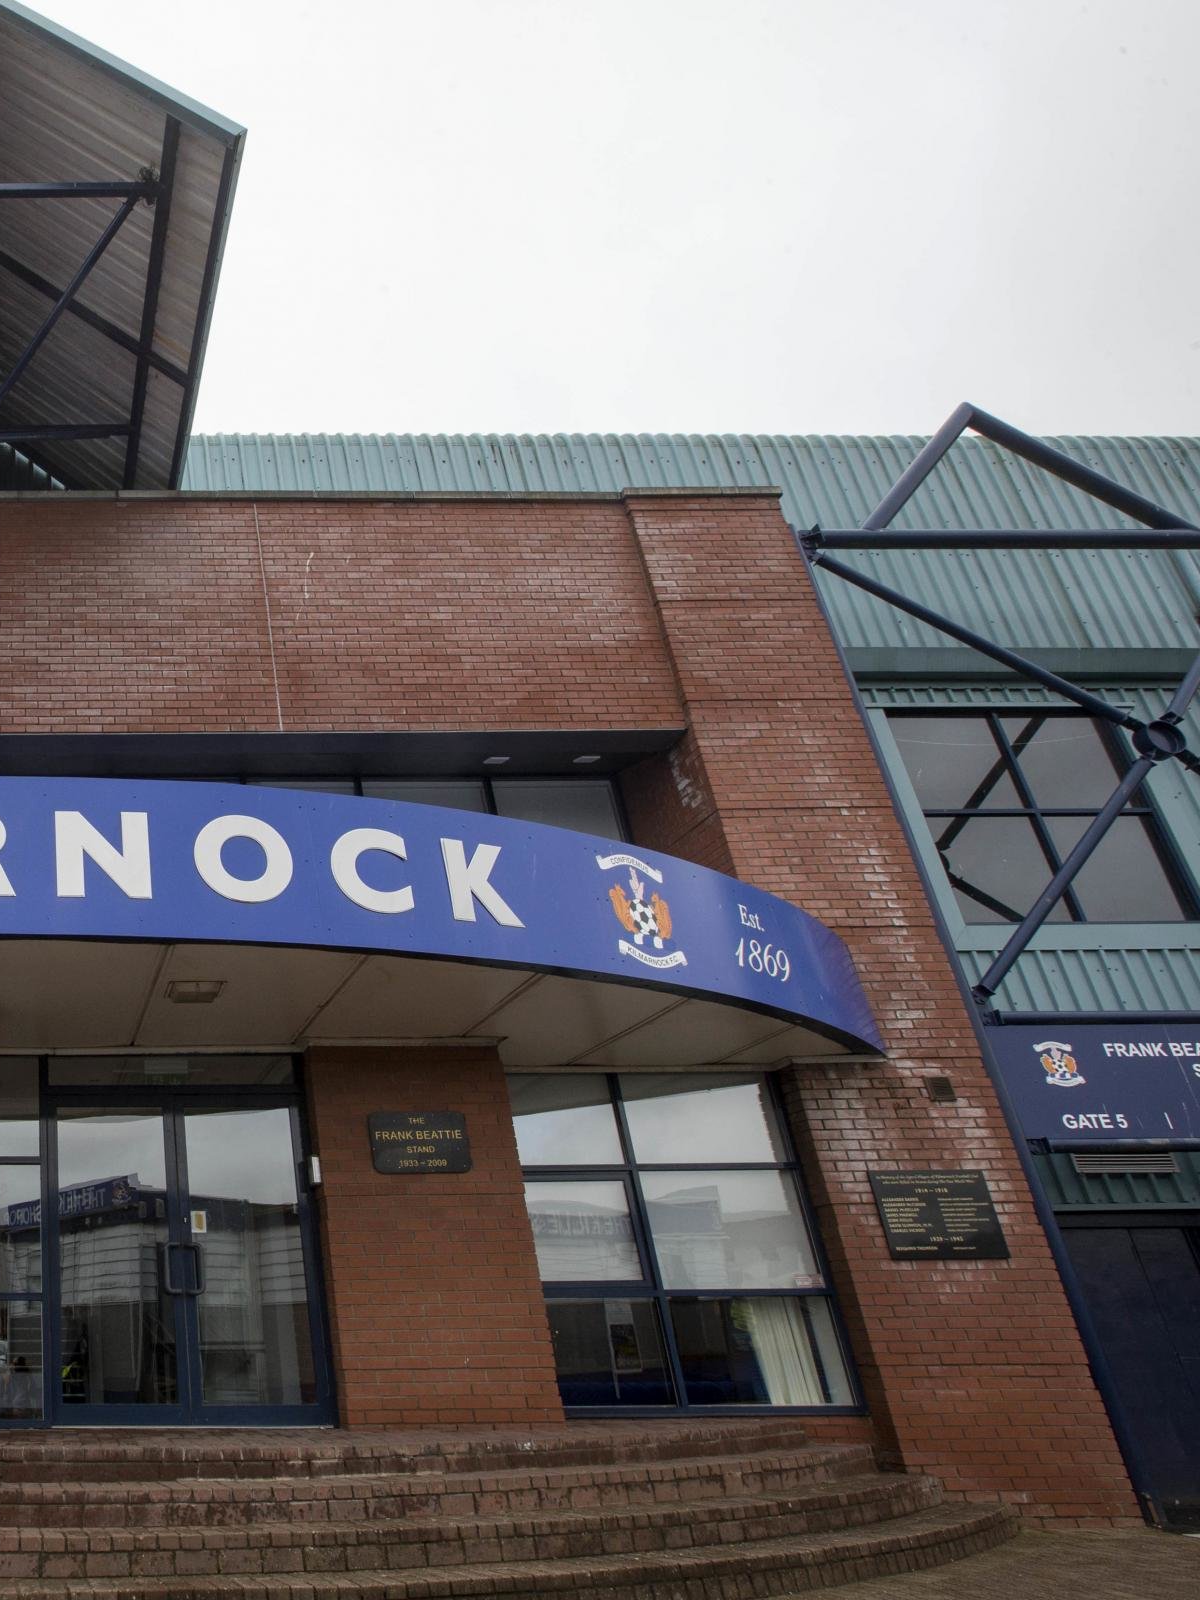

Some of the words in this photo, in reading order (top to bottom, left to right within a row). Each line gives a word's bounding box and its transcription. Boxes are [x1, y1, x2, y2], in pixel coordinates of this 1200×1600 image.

[737, 904, 765, 932] Est.
[735, 938, 791, 982] 1869
[1102, 1043, 1168, 1057] FRANK
[408, 1117, 425, 1125] THE
[1062, 1114, 1114, 1129] GATE
[1116, 1114, 1128, 1129] 5
[375, 1131, 413, 1140] FRANK
[415, 1129, 462, 1140] BEATTIE
[406, 1145, 436, 1153] STAND
